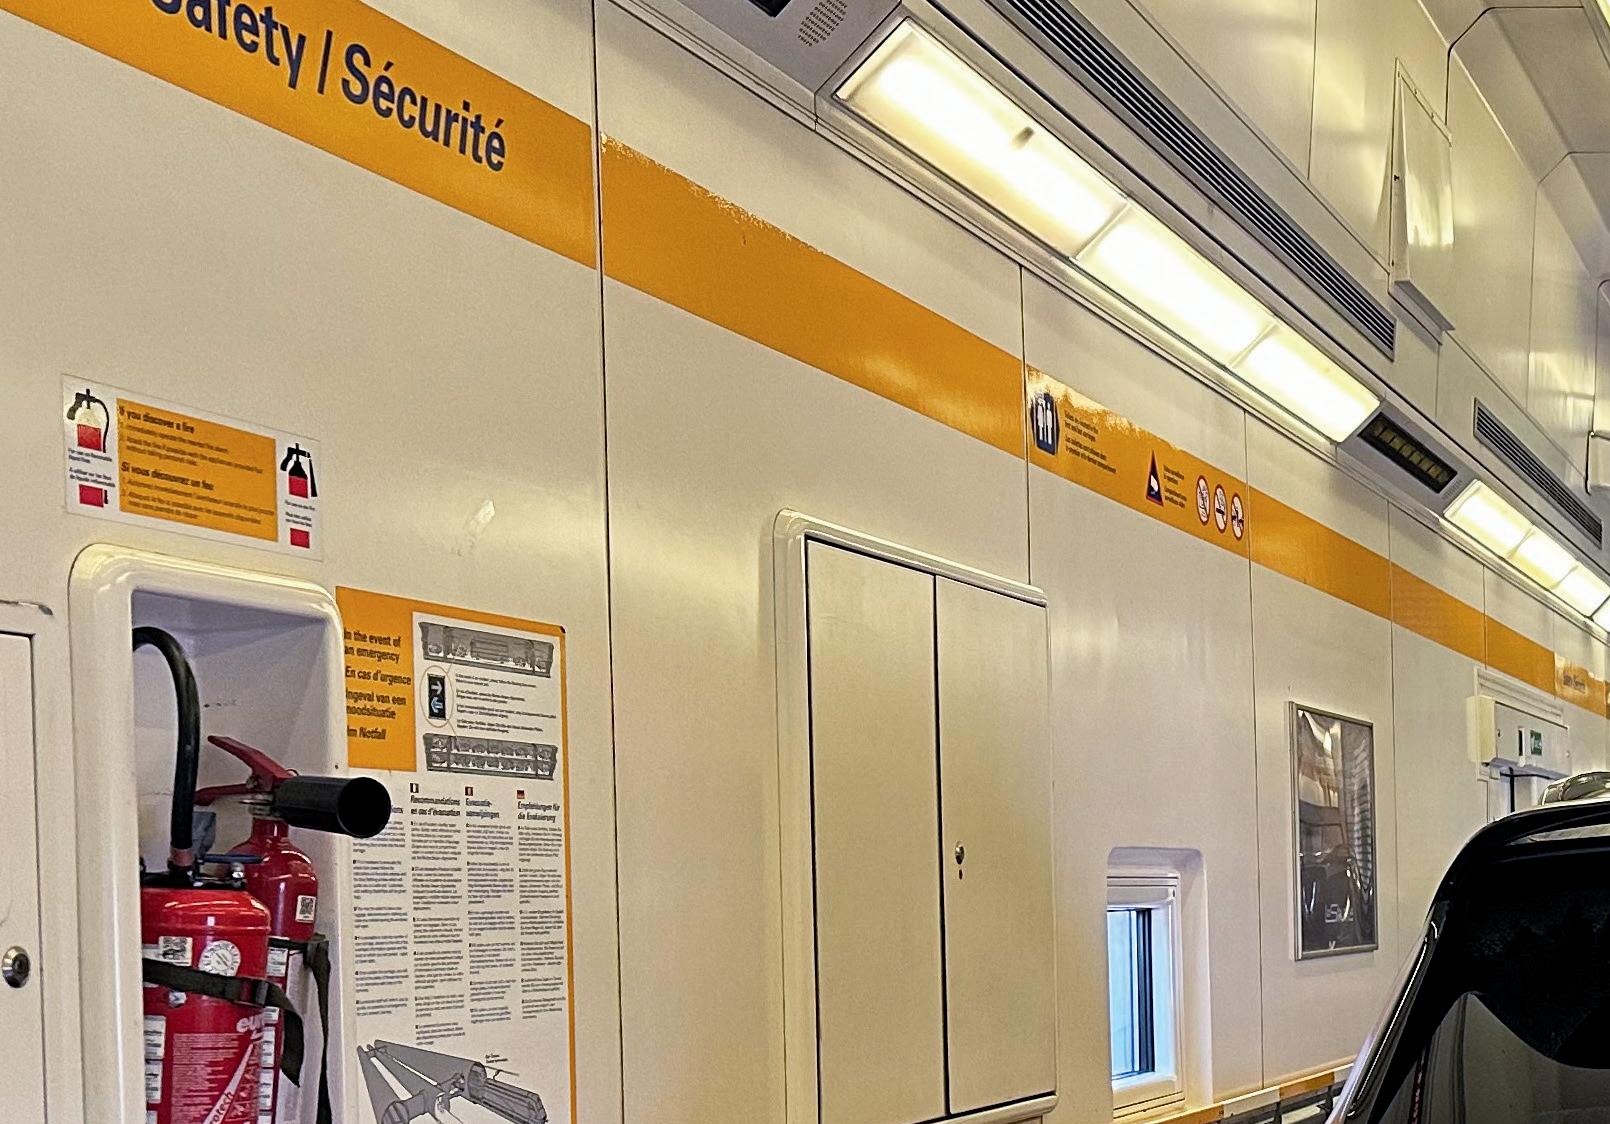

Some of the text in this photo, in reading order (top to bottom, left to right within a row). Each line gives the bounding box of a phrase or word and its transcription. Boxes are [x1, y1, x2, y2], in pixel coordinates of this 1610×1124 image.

[152, 0, 306, 90] afety
[341, 42, 506, 172] Sécurité
[126, 410, 142, 421] you
[143, 411, 174, 429] discover
[120, 461, 130, 473] Si
[131, 465, 150, 477] vous
[353, 630, 368, 643] the
[369, 634, 392, 646] event
[393, 636, 401, 649] of
[356, 647, 400, 664] emergency
[345, 665, 412, 686] En cas d'urgence
[345, 687, 407, 706] Ingeval van een
[359, 726, 387, 740] Notfall
